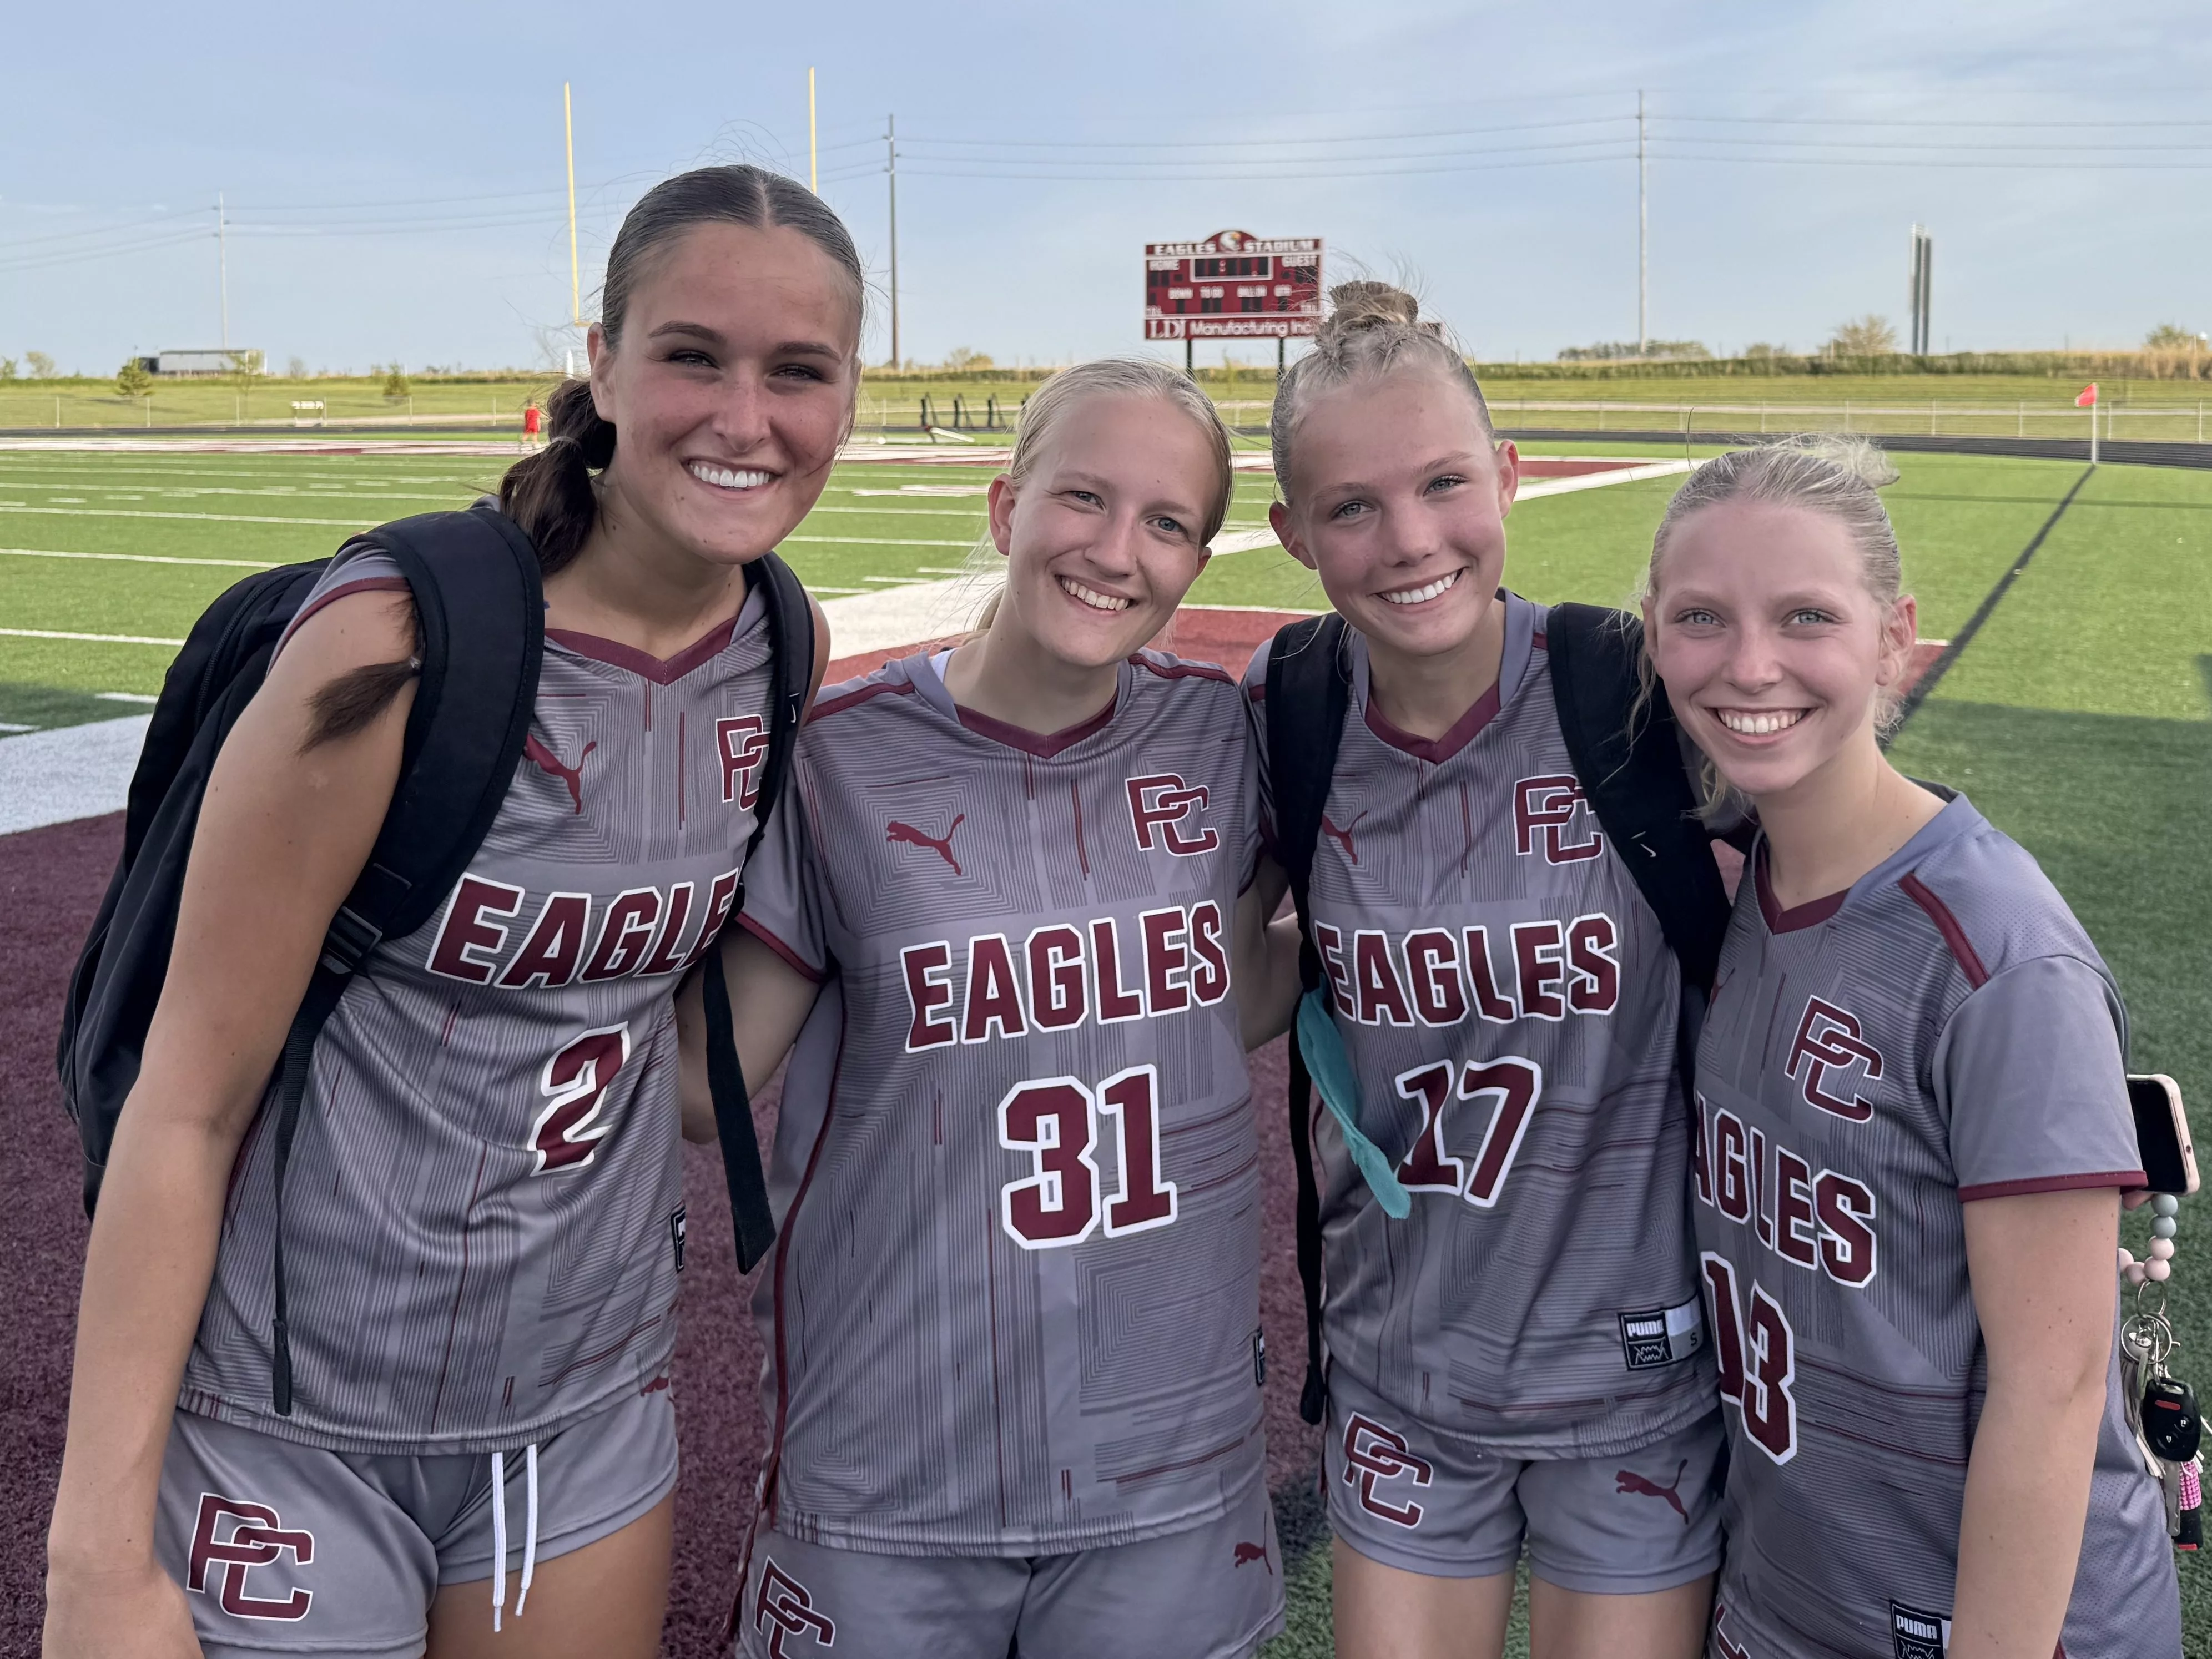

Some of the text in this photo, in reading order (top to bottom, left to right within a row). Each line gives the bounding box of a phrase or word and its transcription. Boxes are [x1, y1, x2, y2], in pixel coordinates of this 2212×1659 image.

[1154, 243, 1216, 255] EAGLES
[425, 868, 740, 989] EAGLE
[900, 899, 1230, 1053] EAGLES
[1314, 912, 1620, 1027] EAGLES
[527, 1021, 630, 1177] 2
[999, 1063, 1177, 1250] 31
[1394, 1055, 1542, 1208] 17
[1695, 1091, 1877, 1289] AGLES
[1690, 1332, 1697, 1347] S
[1701, 1251, 1797, 1466] 13
[1896, 1614, 1937, 1640] PUMA
